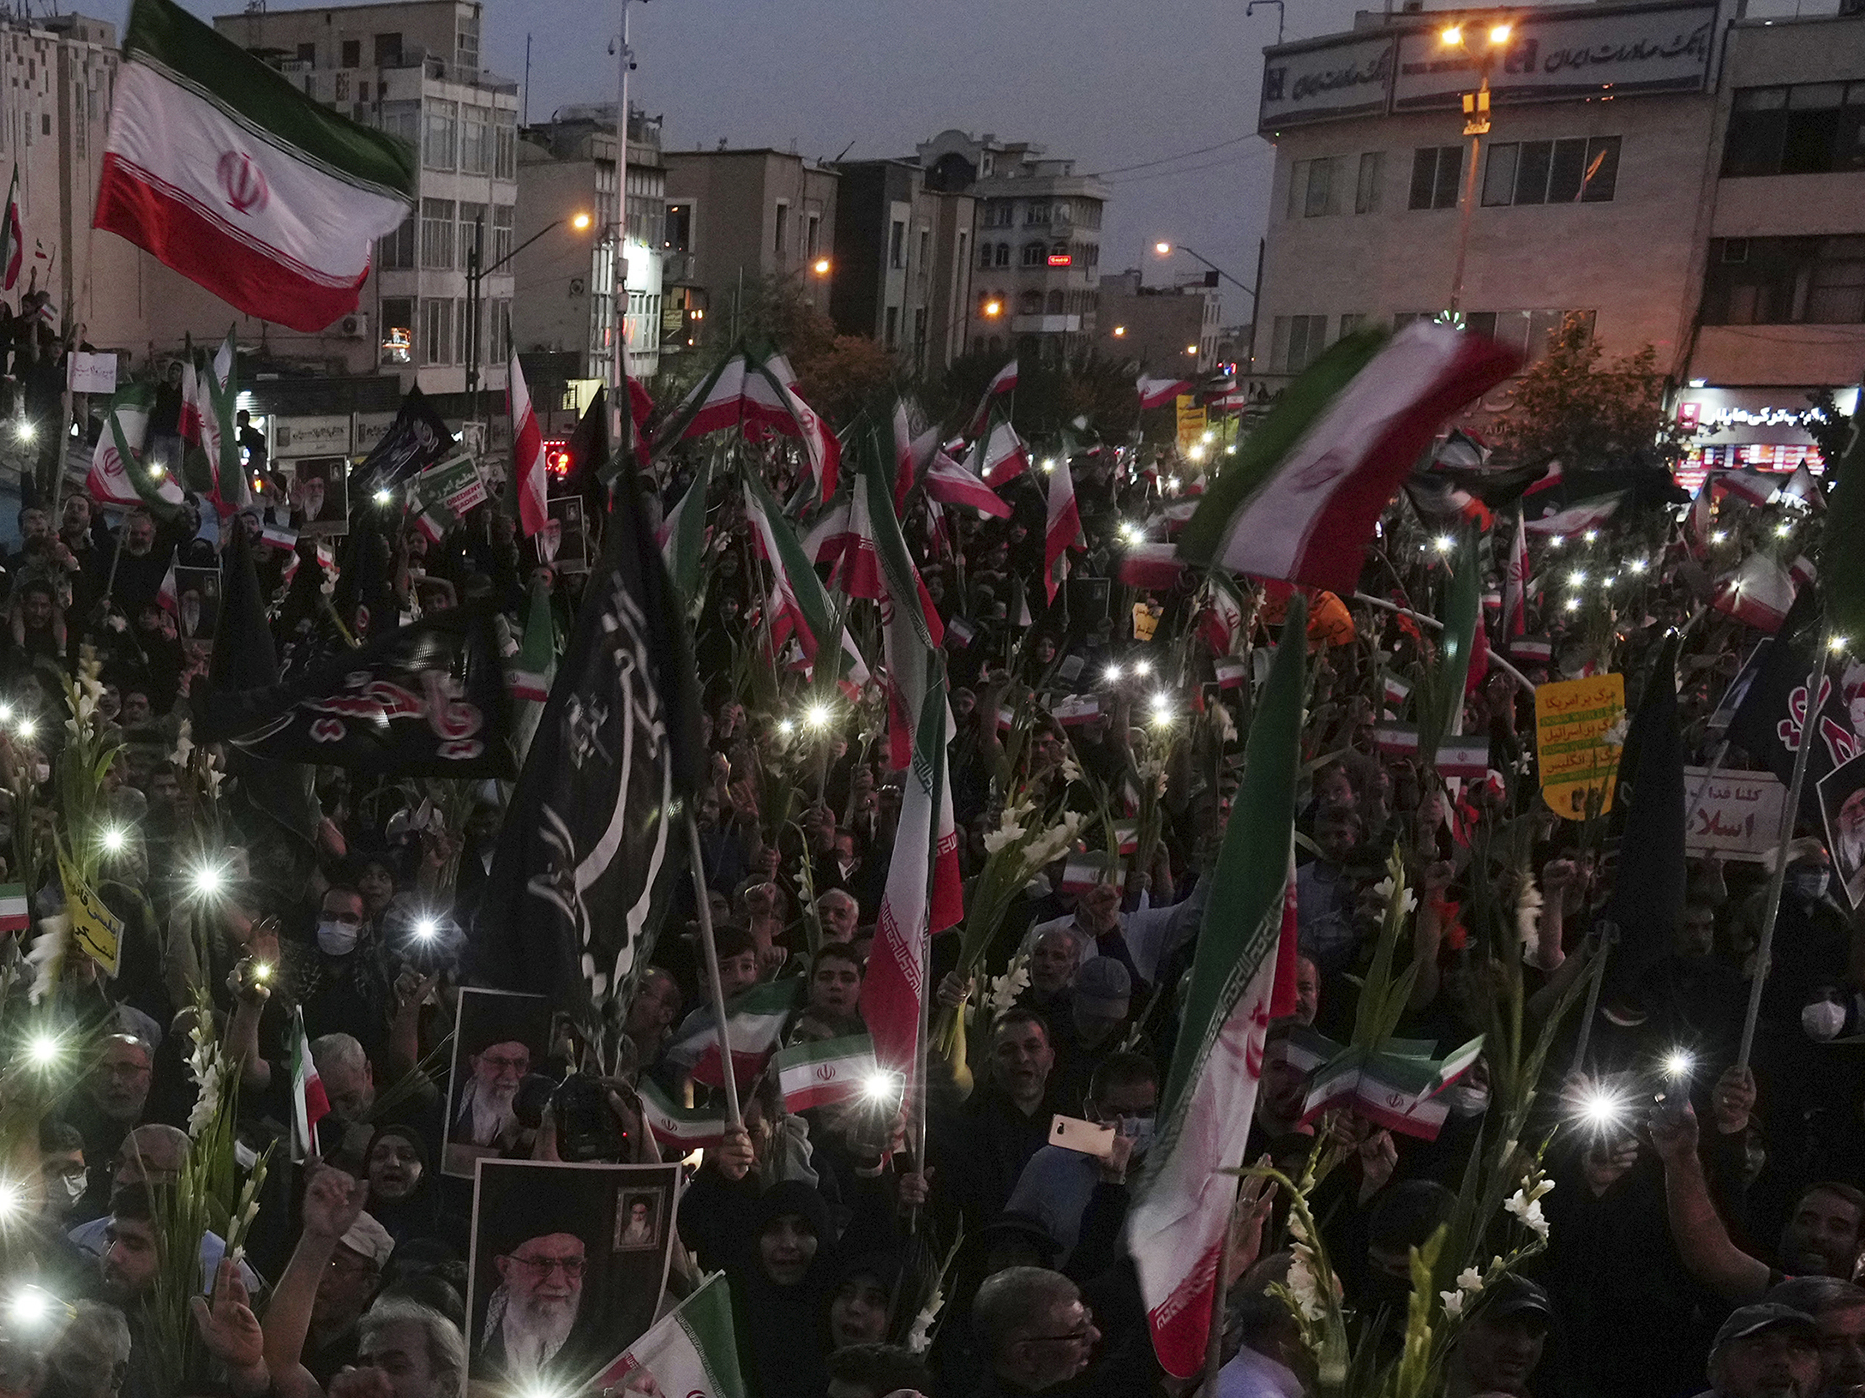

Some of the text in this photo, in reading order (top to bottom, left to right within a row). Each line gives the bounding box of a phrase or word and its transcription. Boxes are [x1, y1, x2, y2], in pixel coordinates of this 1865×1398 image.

[1748, 406, 1786, 426] ترکی
[446, 483, 481, 506] OBEDIENT
[456, 494, 479, 511] EADER
